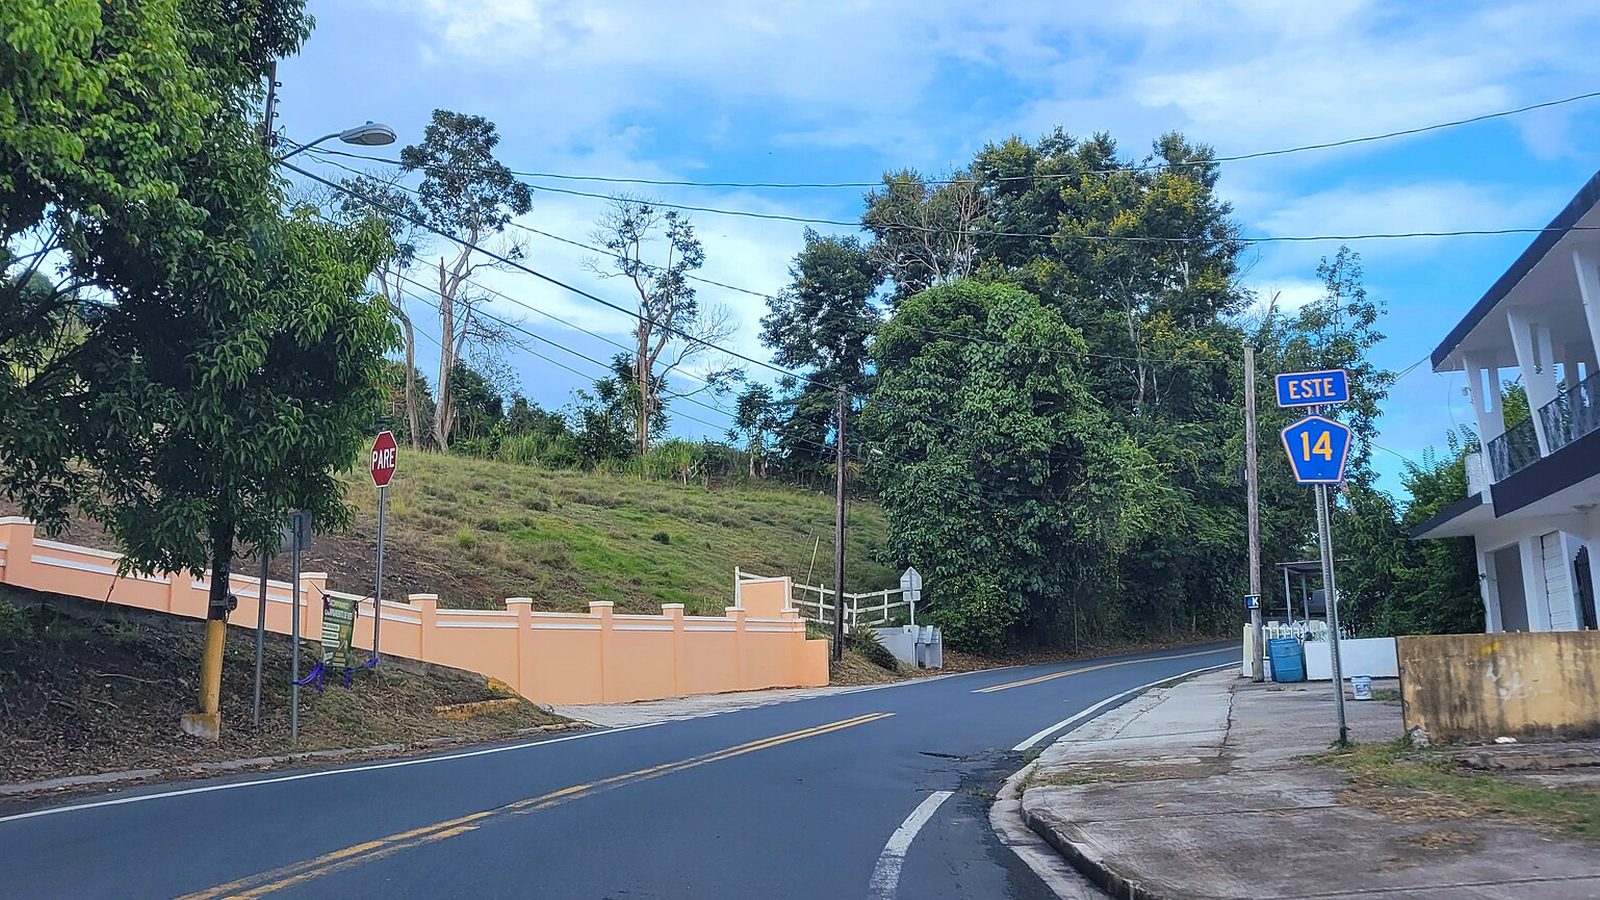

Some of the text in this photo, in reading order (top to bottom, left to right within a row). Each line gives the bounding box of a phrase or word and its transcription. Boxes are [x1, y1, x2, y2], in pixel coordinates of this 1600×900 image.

[1288, 378, 1336, 399] ESTE
[1300, 431, 1333, 461] 14
[372, 447, 395, 470] PARE
